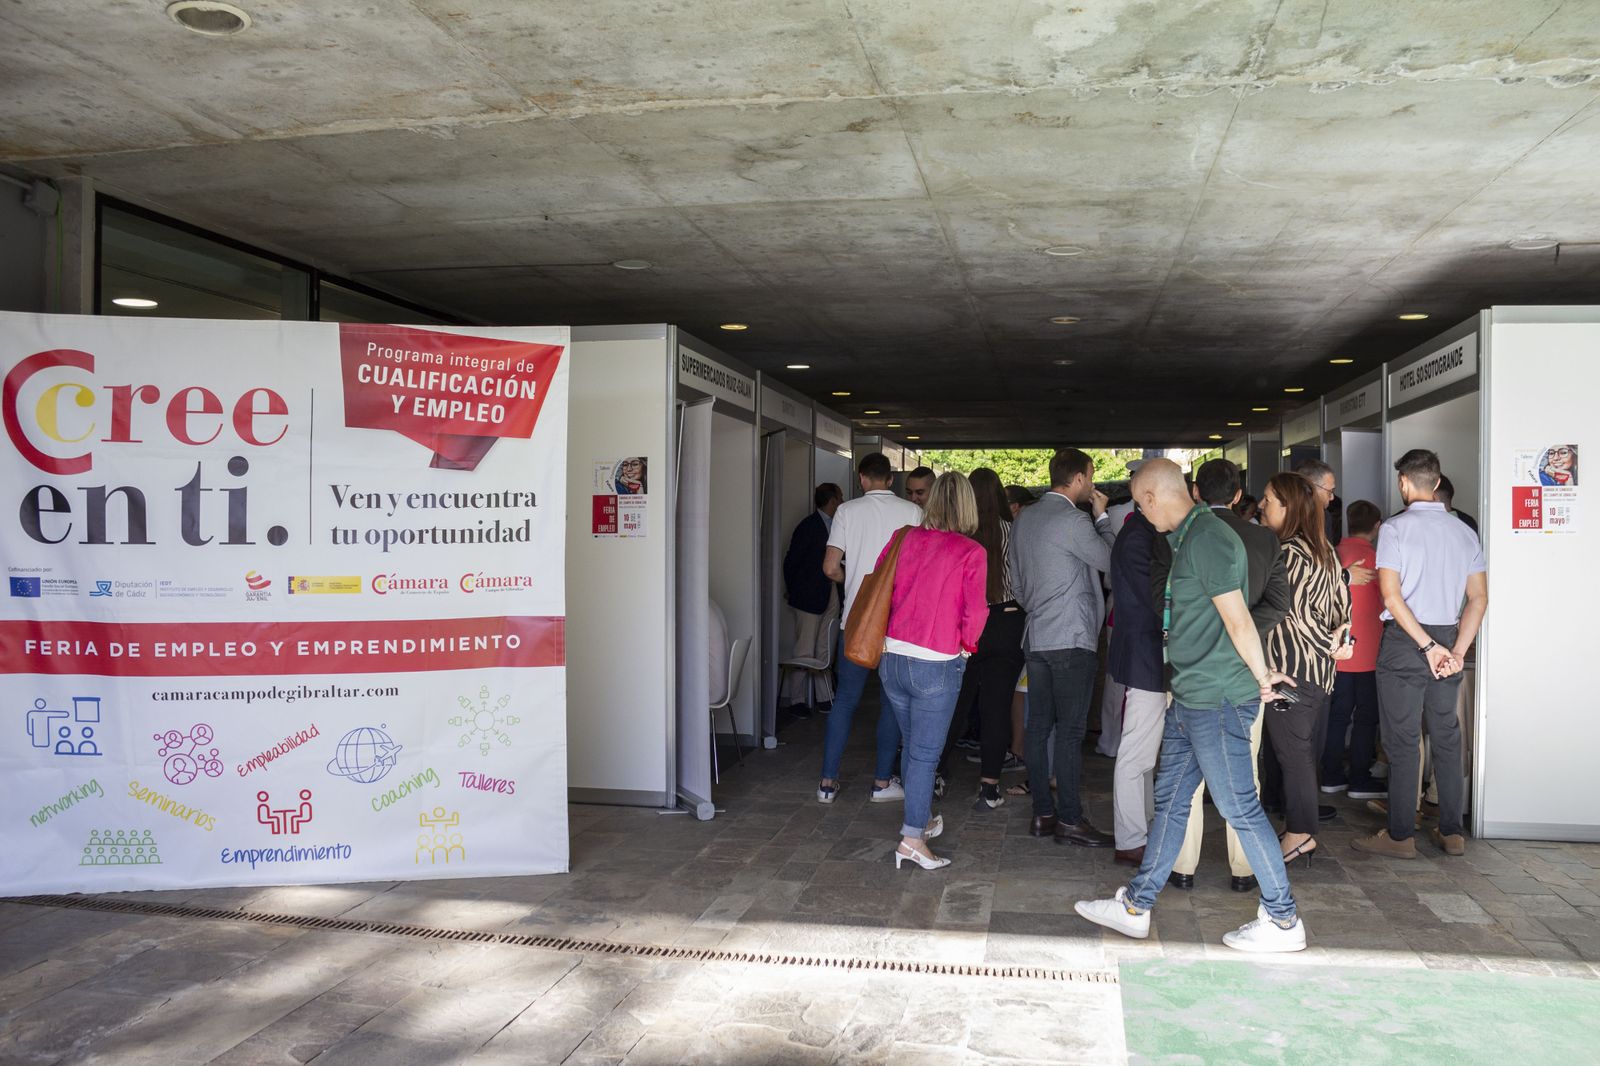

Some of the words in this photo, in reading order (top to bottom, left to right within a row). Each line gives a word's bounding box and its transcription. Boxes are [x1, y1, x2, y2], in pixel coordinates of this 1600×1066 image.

[367, 342, 443, 365] Programa
[450, 352, 511, 372] integral
[516, 360, 535, 373] de
[682, 353, 725, 388] SUPERMERCADOS
[357, 364, 537, 400] CUALIFICACIÓN
[391, 394, 406, 414] Y
[413, 397, 506, 424] EMPLEO
[19, 484, 157, 545] en
[174, 455, 289, 546] ti.
[328, 484, 382, 509] Ven
[386, 493, 402, 517] y
[406, 489, 538, 509] encuentra
[1524, 499, 1539, 507] FERIA
[1519, 519, 1539, 528] EMPLEO
[1549, 518, 1566, 526] mayo
[331, 525, 359, 545] tu
[364, 519, 532, 553] oportunidad
[115, 580, 153, 589] Diputación
[115, 590, 124, 598] de
[126, 589, 146, 598] Cádiz
[372, 573, 449, 595] Cámara
[460, 571, 533, 593] Cámara
[25, 639, 98, 656] FERIA
[110, 642, 141, 657] DE
[154, 641, 257, 657] EMPLEO
[270, 641, 284, 656] Y
[298, 634, 521, 656] EMPRENDIMIENTO
[152, 685, 399, 704] camaracampodegibraltar.com
[237, 723, 320, 778] Empleabilidad
[458, 771, 516, 796] Talleres
[30, 778, 105, 828] networking
[128, 780, 217, 832] Seminarios
[221, 843, 352, 869] Emprendimiento
